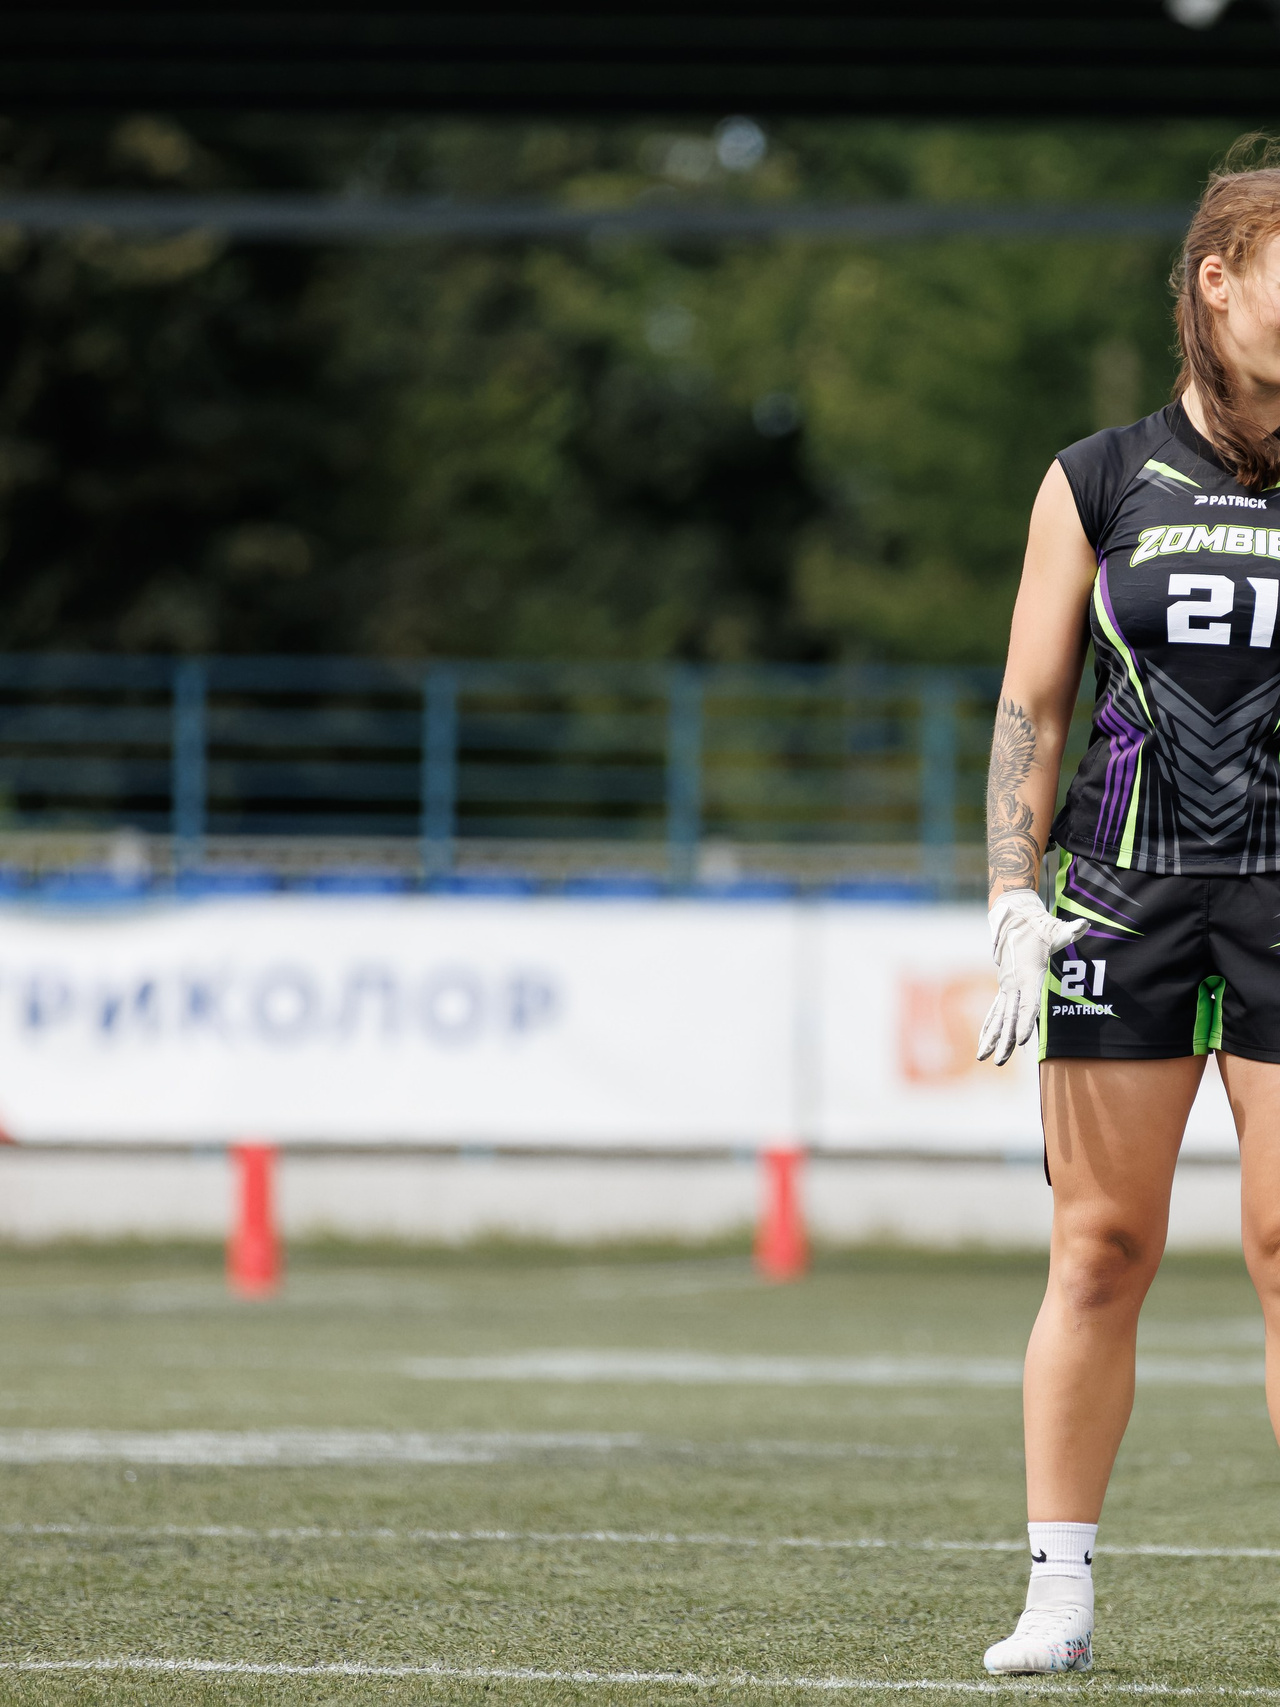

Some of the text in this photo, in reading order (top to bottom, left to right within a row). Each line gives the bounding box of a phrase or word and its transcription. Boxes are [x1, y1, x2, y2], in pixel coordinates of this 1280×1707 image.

[1208, 495, 1268, 510] PATRICK
[1166, 573, 1280, 649] 21
[1060, 959, 1107, 997] 21
[3, 962, 568, 1052] РИКОЛОР
[1061, 1004, 1114, 1017] PATRICK
